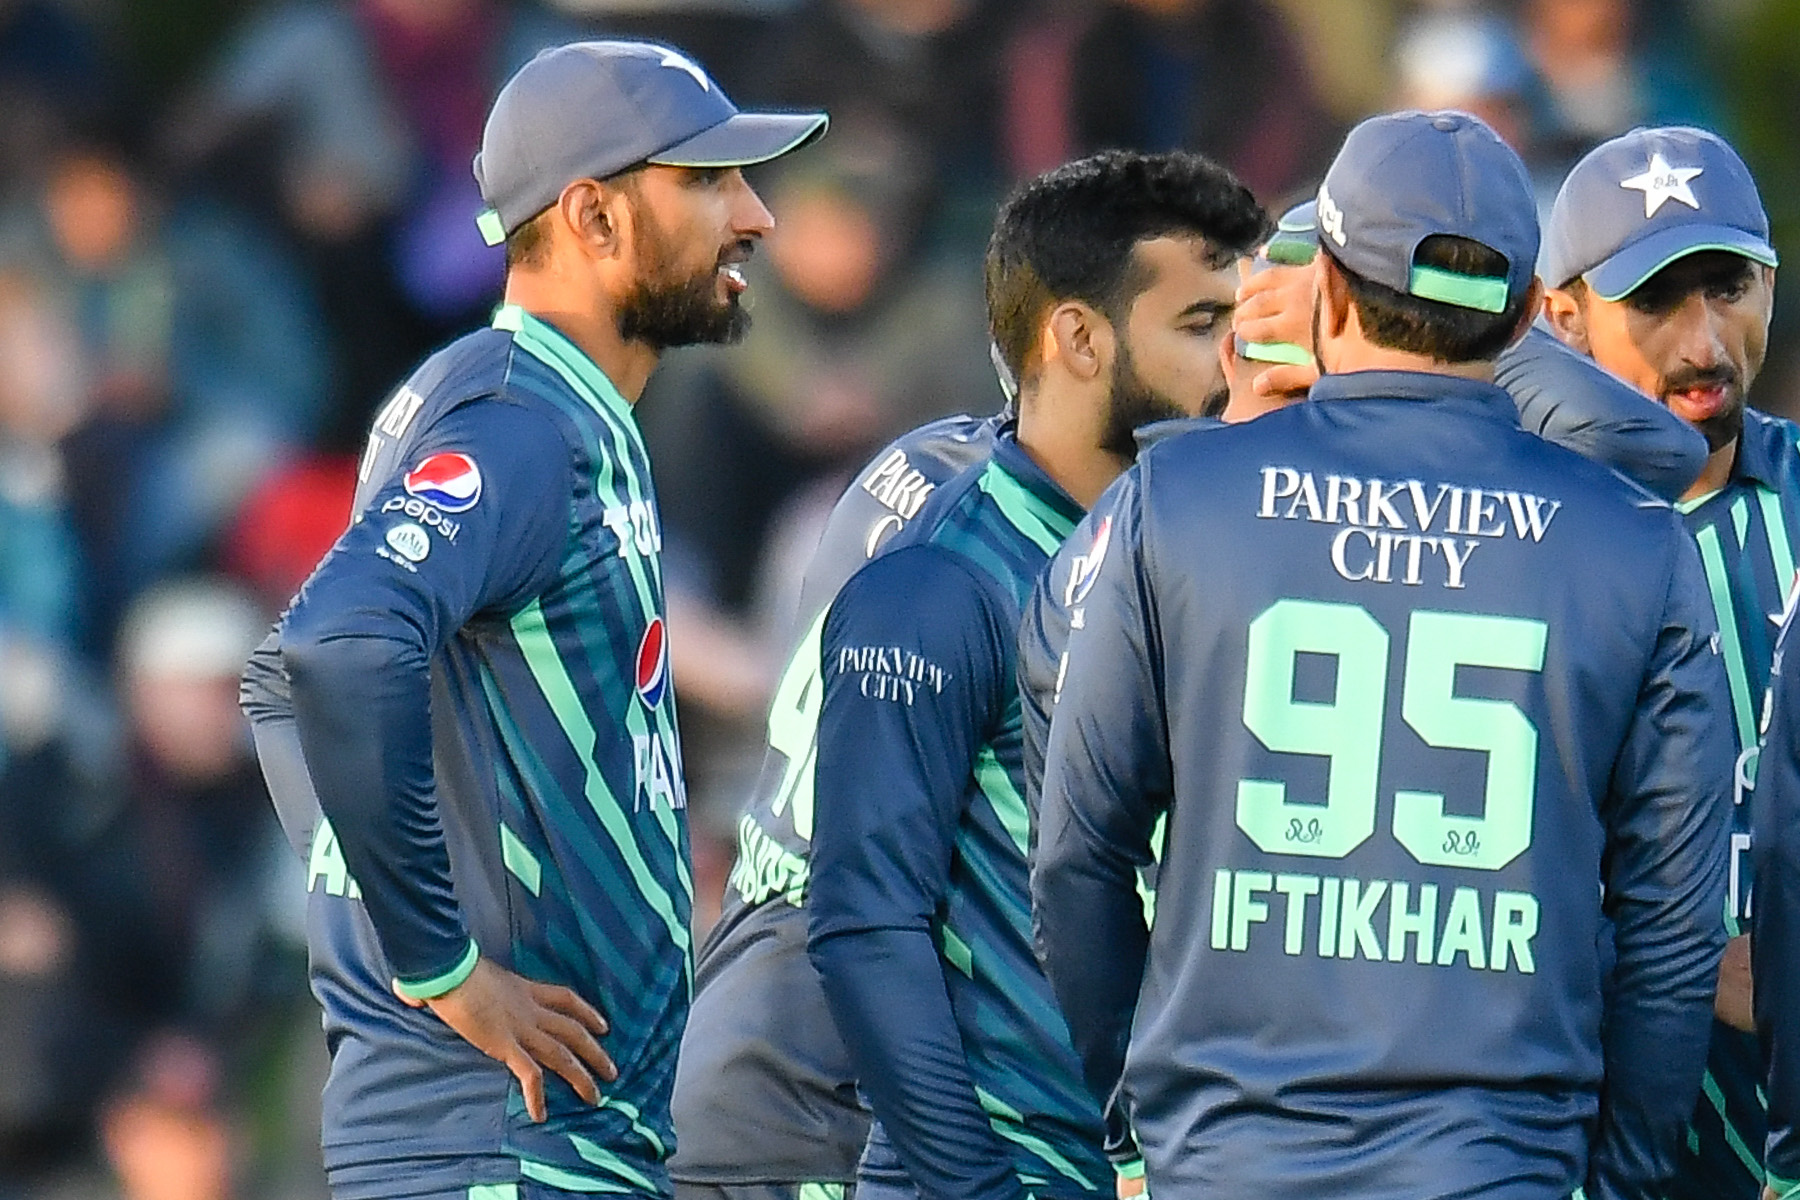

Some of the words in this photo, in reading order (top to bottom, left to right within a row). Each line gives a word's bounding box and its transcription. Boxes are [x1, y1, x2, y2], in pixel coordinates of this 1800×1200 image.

[382, 495, 461, 547] pepsi
[1256, 466, 1562, 543] PARKVIEW
[1331, 526, 1480, 589] CITY
[861, 673, 921, 706] CITY
[1236, 598, 1550, 870] 95
[1209, 869, 1539, 974] IFTIKHAR
